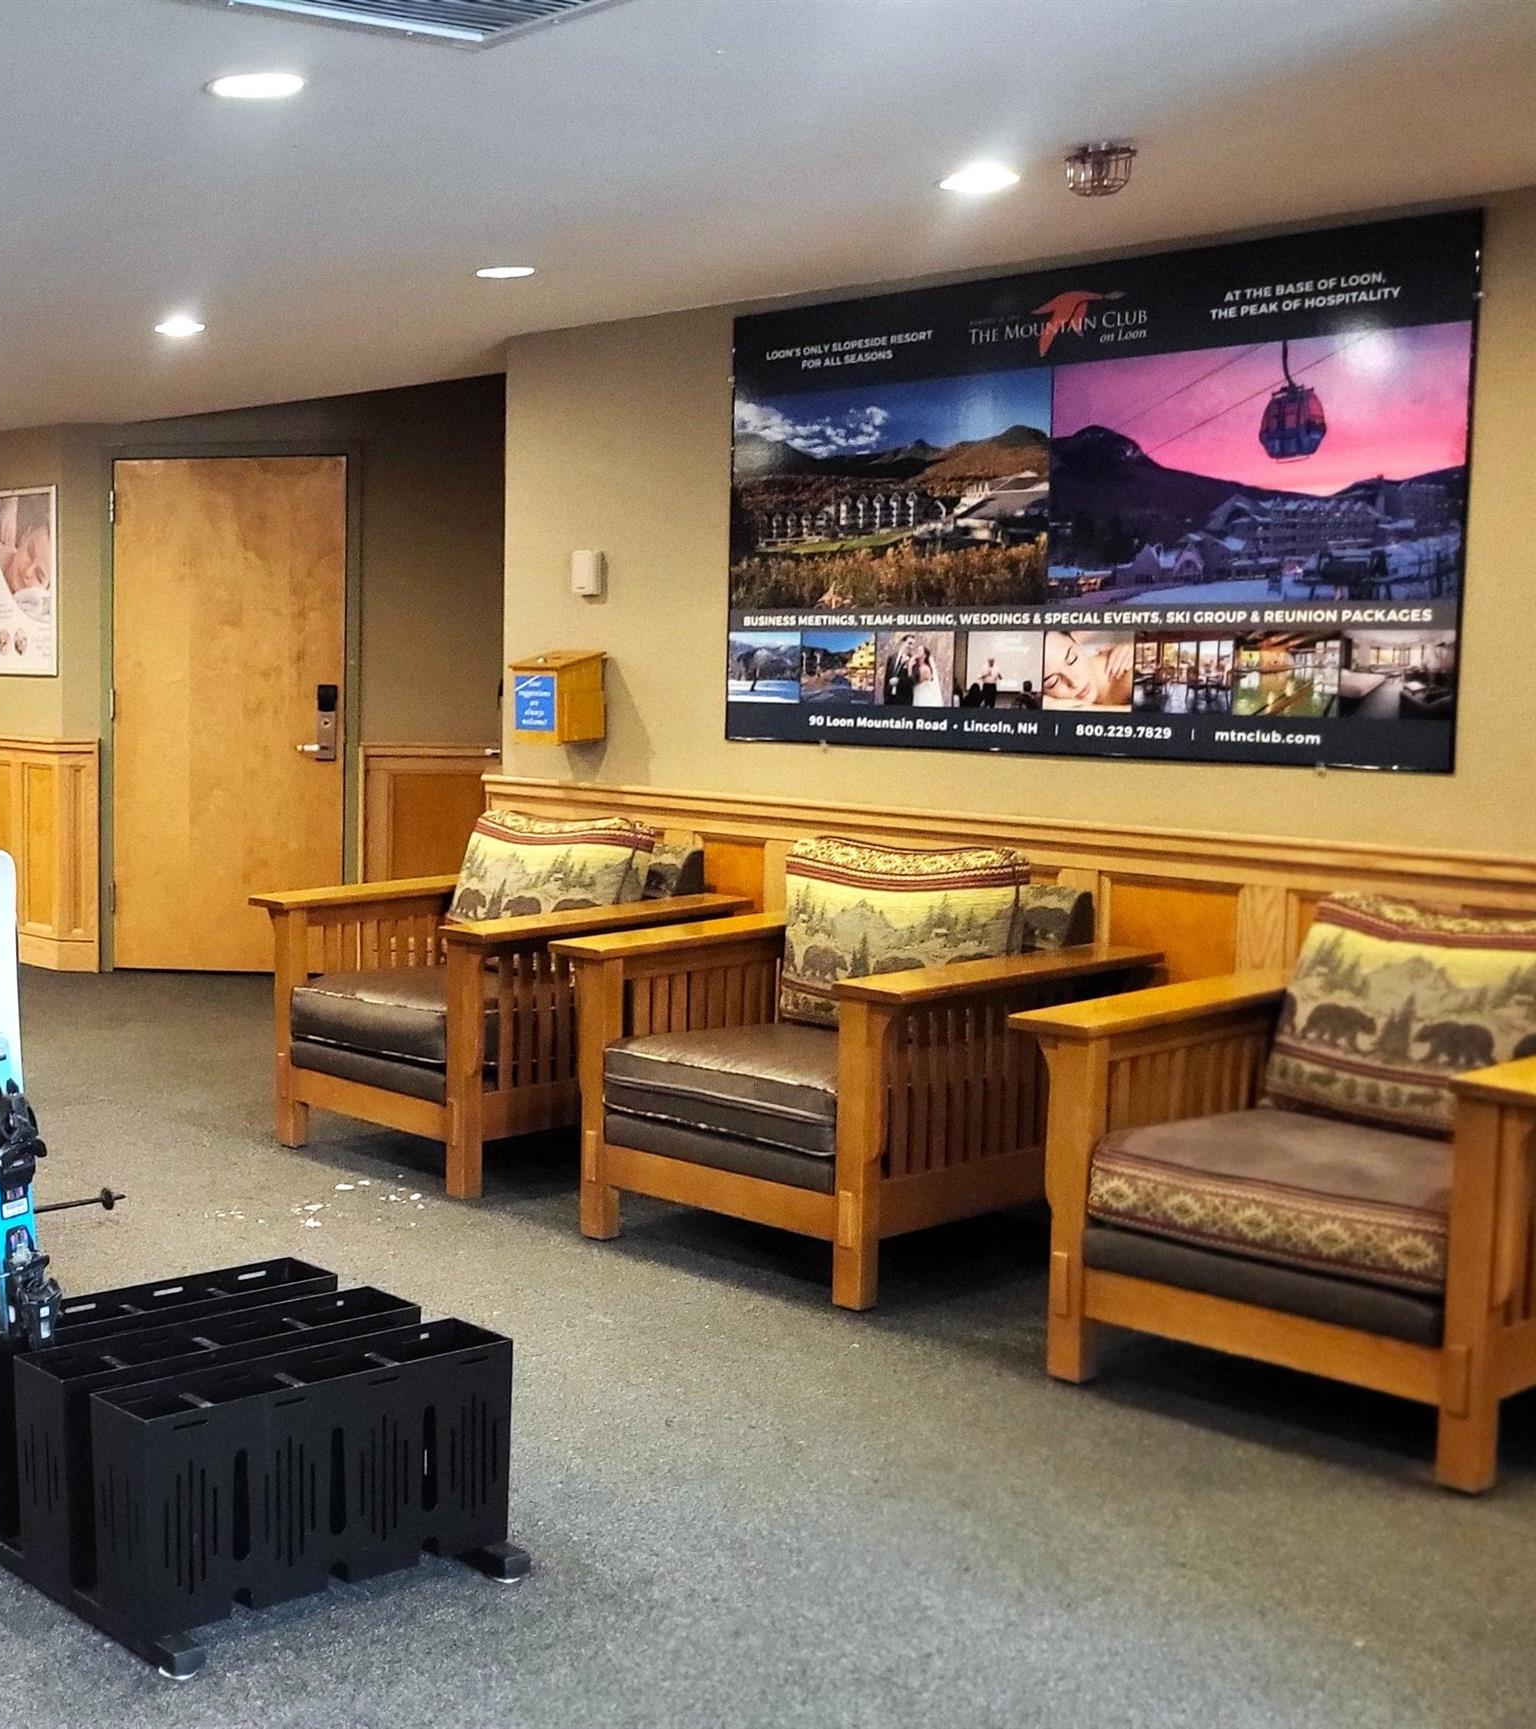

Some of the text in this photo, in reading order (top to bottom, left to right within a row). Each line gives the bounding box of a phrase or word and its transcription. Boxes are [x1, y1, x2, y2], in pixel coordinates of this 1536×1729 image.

[1224, 290, 1241, 302] AT
[1244, 286, 1272, 299] THE
[1275, 280, 1314, 296] BASE
[1317, 277, 1337, 290] OF
[1209, 286, 1401, 320] THE PEAK OF HOSPITALITY
[968, 328, 999, 344] THE
[1102, 310, 1148, 328] CLUB
[1099, 329, 1147, 344] on Loon
[766, 330, 933, 361] LOON'S ONLY SLOPESIDE RESORT
[801, 350, 893, 370] FOR ALL SEASONS
[743, 608, 1433, 627] BUSINESS MEETINGS, TEAM-BUILDING, WEDDINGS & SPECIAL EVENTS, SKI GROUP & REUNION PACKAGES
[808, 715, 1038, 734] 90 Loon Mountain Road Lincoln, NH
[1075, 724, 1321, 745] 800.229.7829 mtnclub.com
